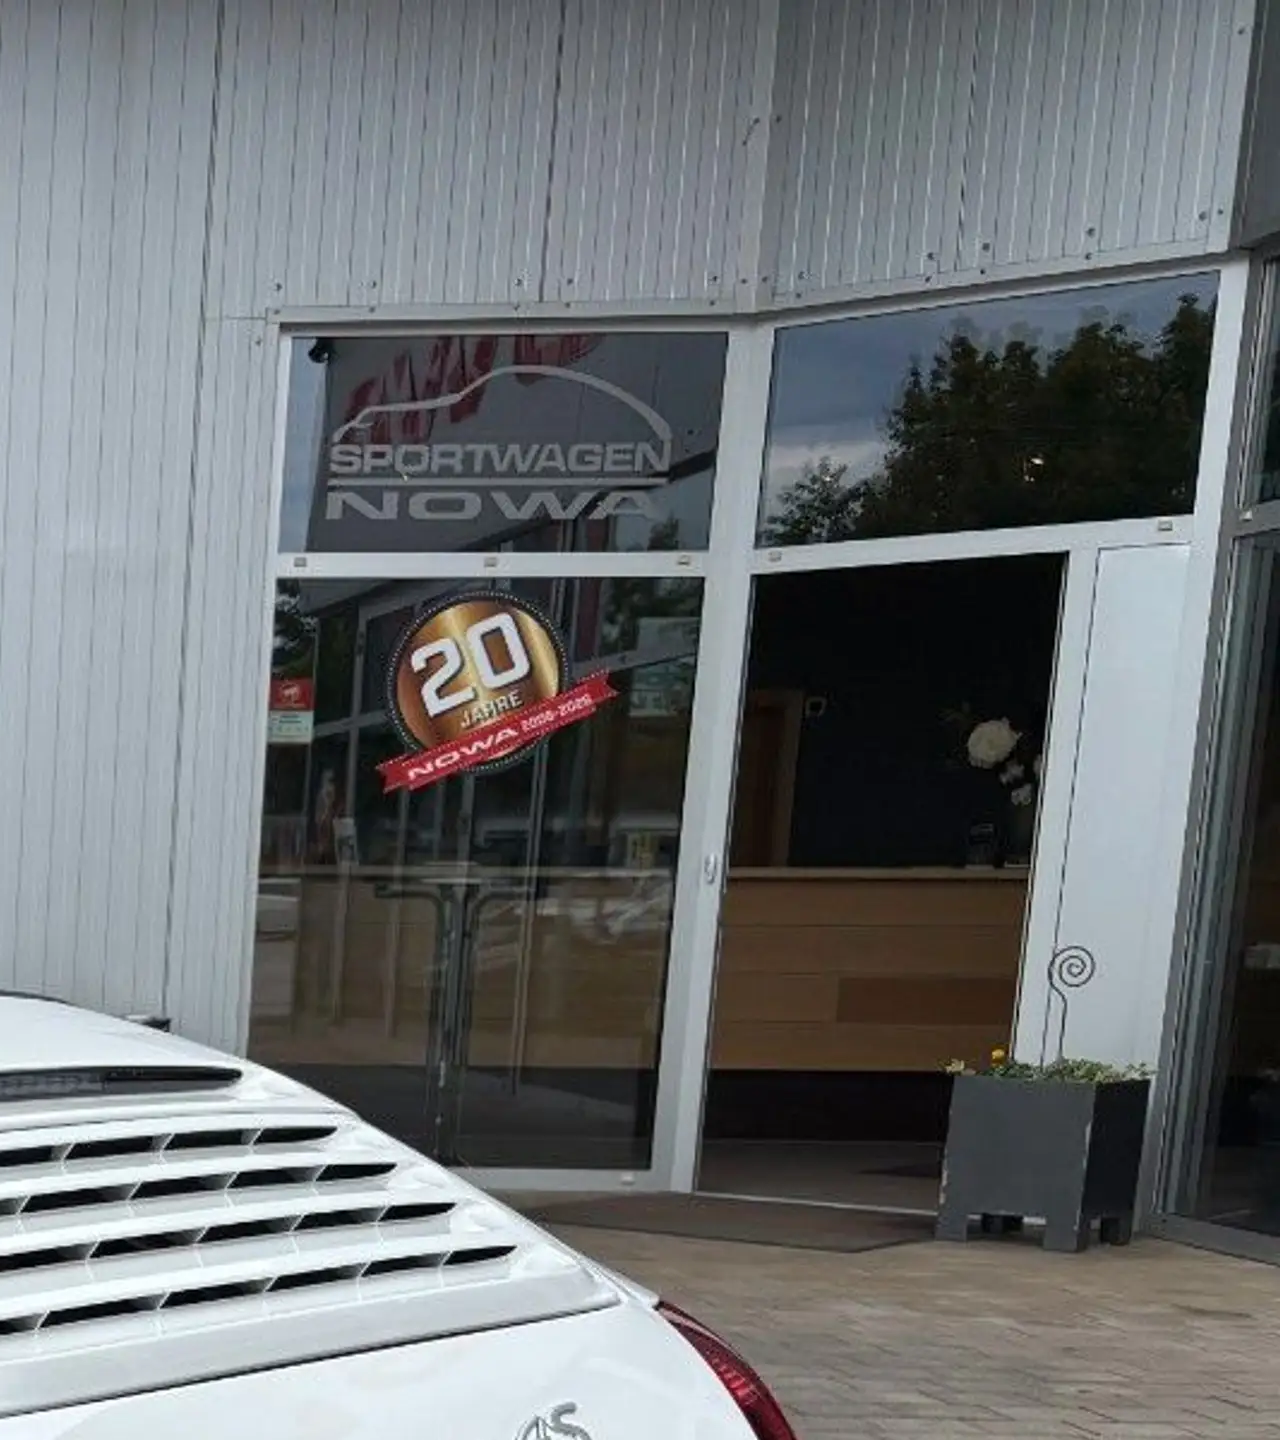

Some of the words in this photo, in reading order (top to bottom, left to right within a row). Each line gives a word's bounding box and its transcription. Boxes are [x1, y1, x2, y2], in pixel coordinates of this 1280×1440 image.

[329, 441, 672, 474] SPORTWAGEN
[325, 491, 660, 520] NOWA
[411, 612, 531, 718] 20
[460, 690, 523, 729] JAHRE
[407, 727, 520, 782] NOWA
